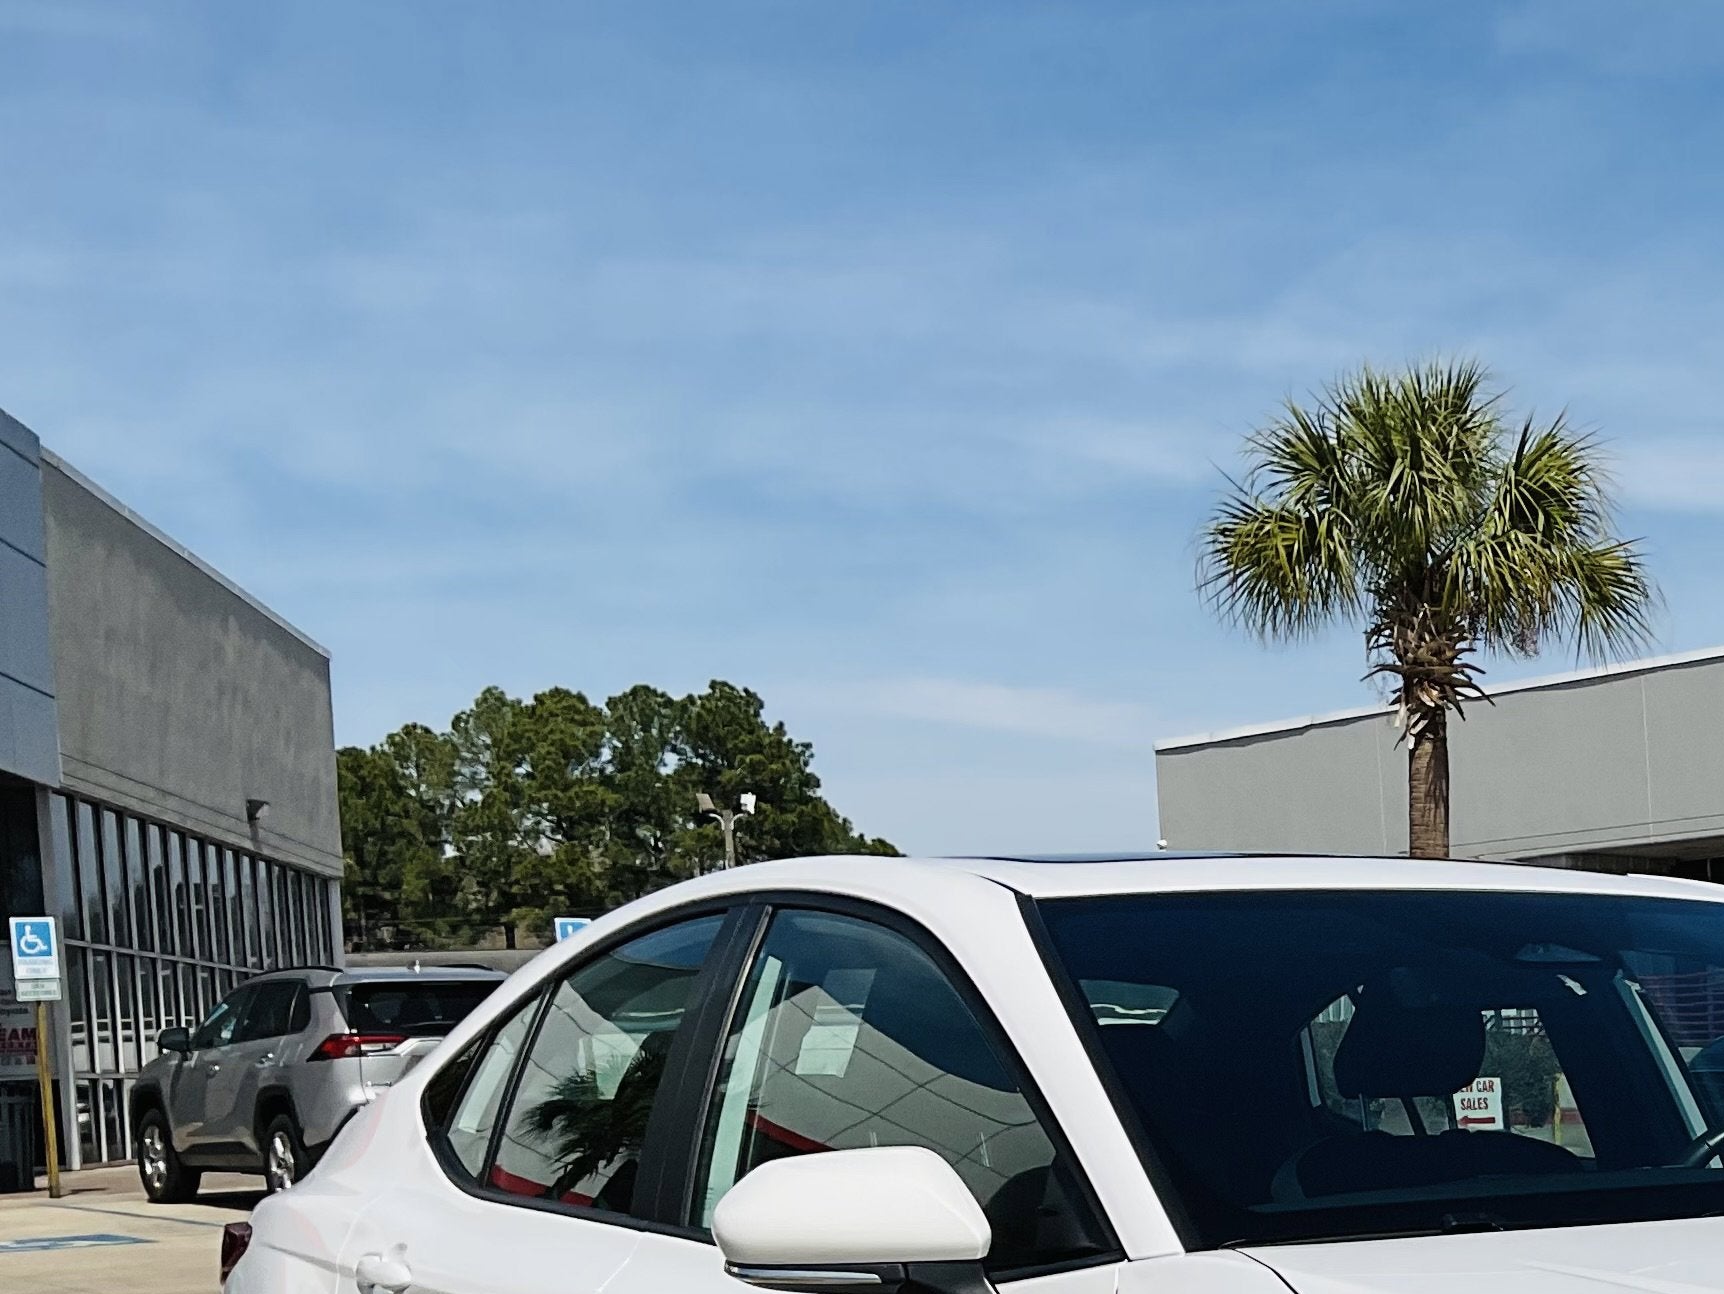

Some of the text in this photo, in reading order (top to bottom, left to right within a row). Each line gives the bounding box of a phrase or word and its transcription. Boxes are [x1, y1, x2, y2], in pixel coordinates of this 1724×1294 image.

[0, 1027, 37, 1041] EAM
[1475, 1080, 1495, 1093] CAR
[1460, 1097, 1489, 1111] SALES
